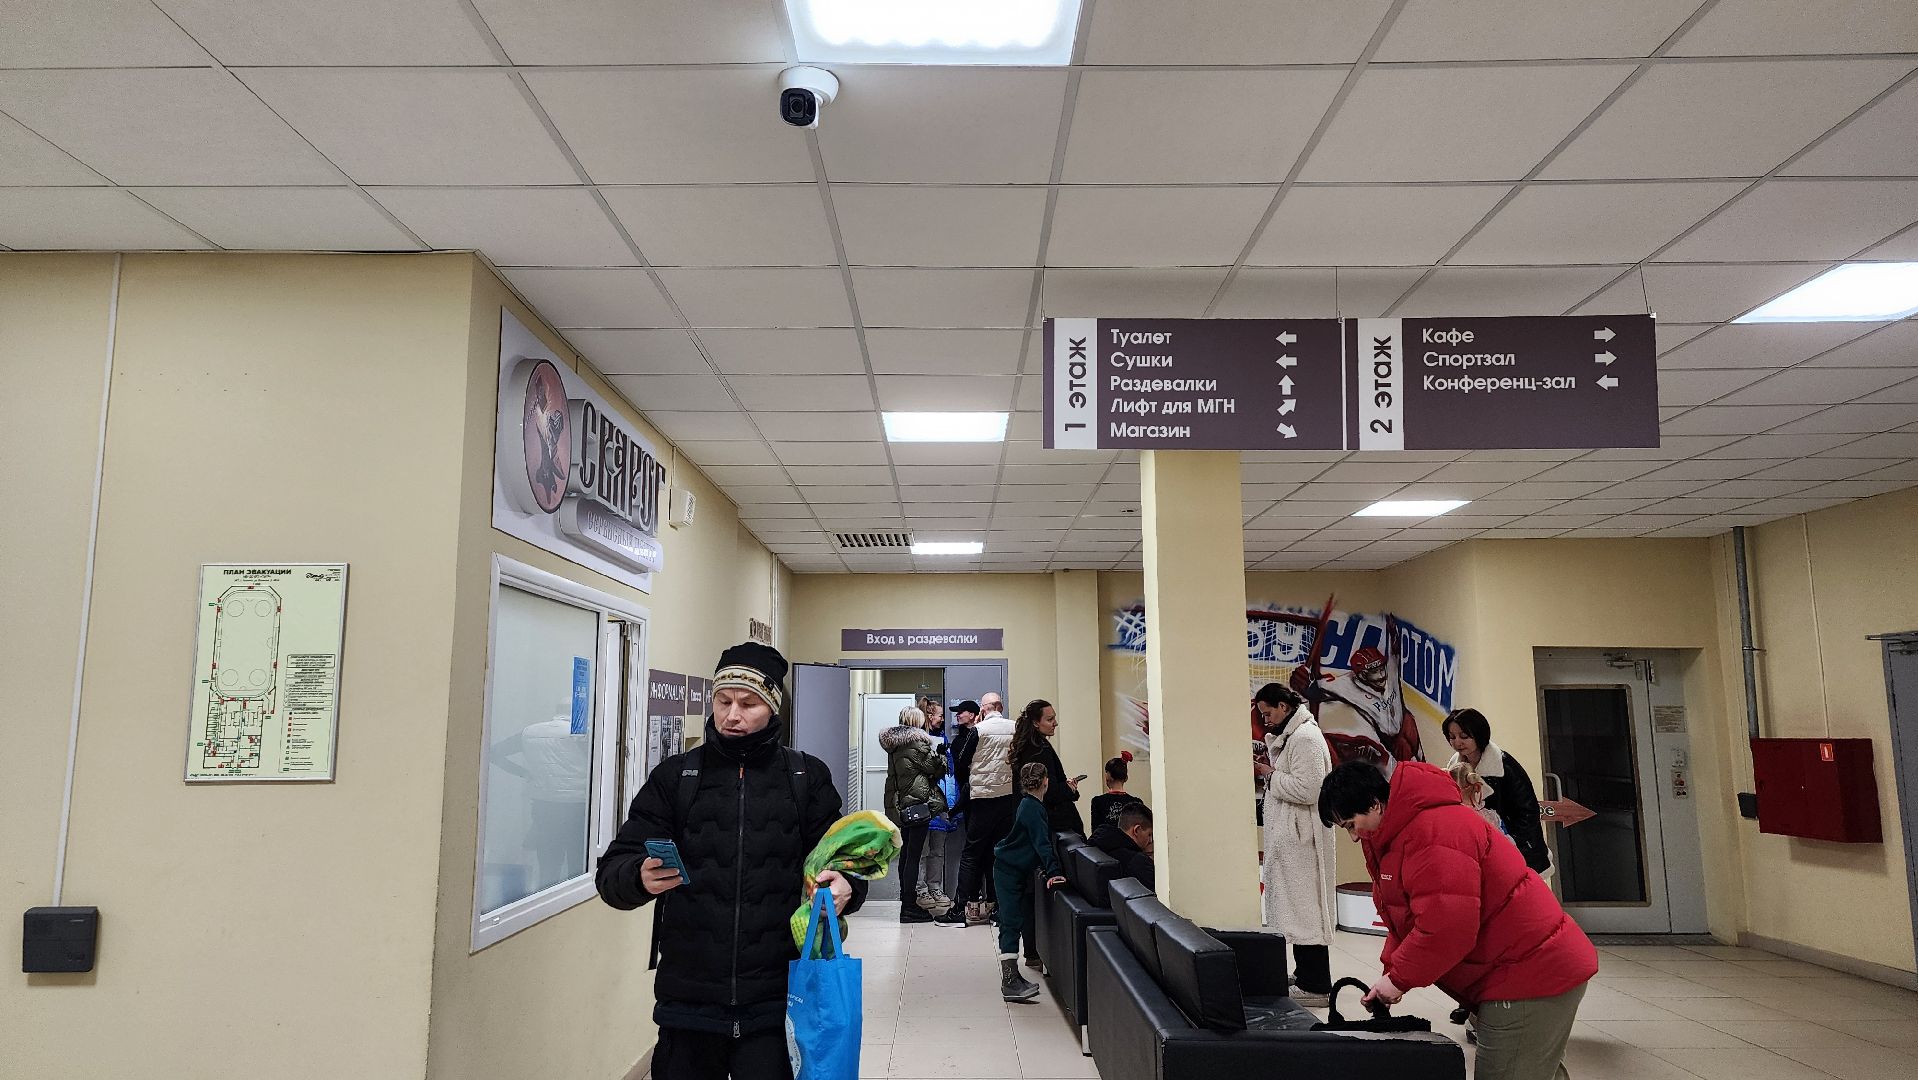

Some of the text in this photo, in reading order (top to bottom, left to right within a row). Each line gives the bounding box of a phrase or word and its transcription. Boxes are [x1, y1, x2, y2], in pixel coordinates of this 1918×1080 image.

[1110, 328, 1173, 347] Туалет
[1422, 328, 1474, 346] Кафе
[1110, 352, 1173, 370] Сушки
[1423, 351, 1516, 369] Спортзал
[1065, 337, 1087, 431] 1 этаж
[1110, 376, 1217, 392] Раздевалки
[1370, 335, 1392, 434] 2 этаж
[1423, 374, 1576, 393] Конференц-зал
[1110, 398, 1235, 416] Лифт для МГН
[1110, 422, 1191, 438] Магазин
[866, 633, 978, 646] Вход в раздевалки
